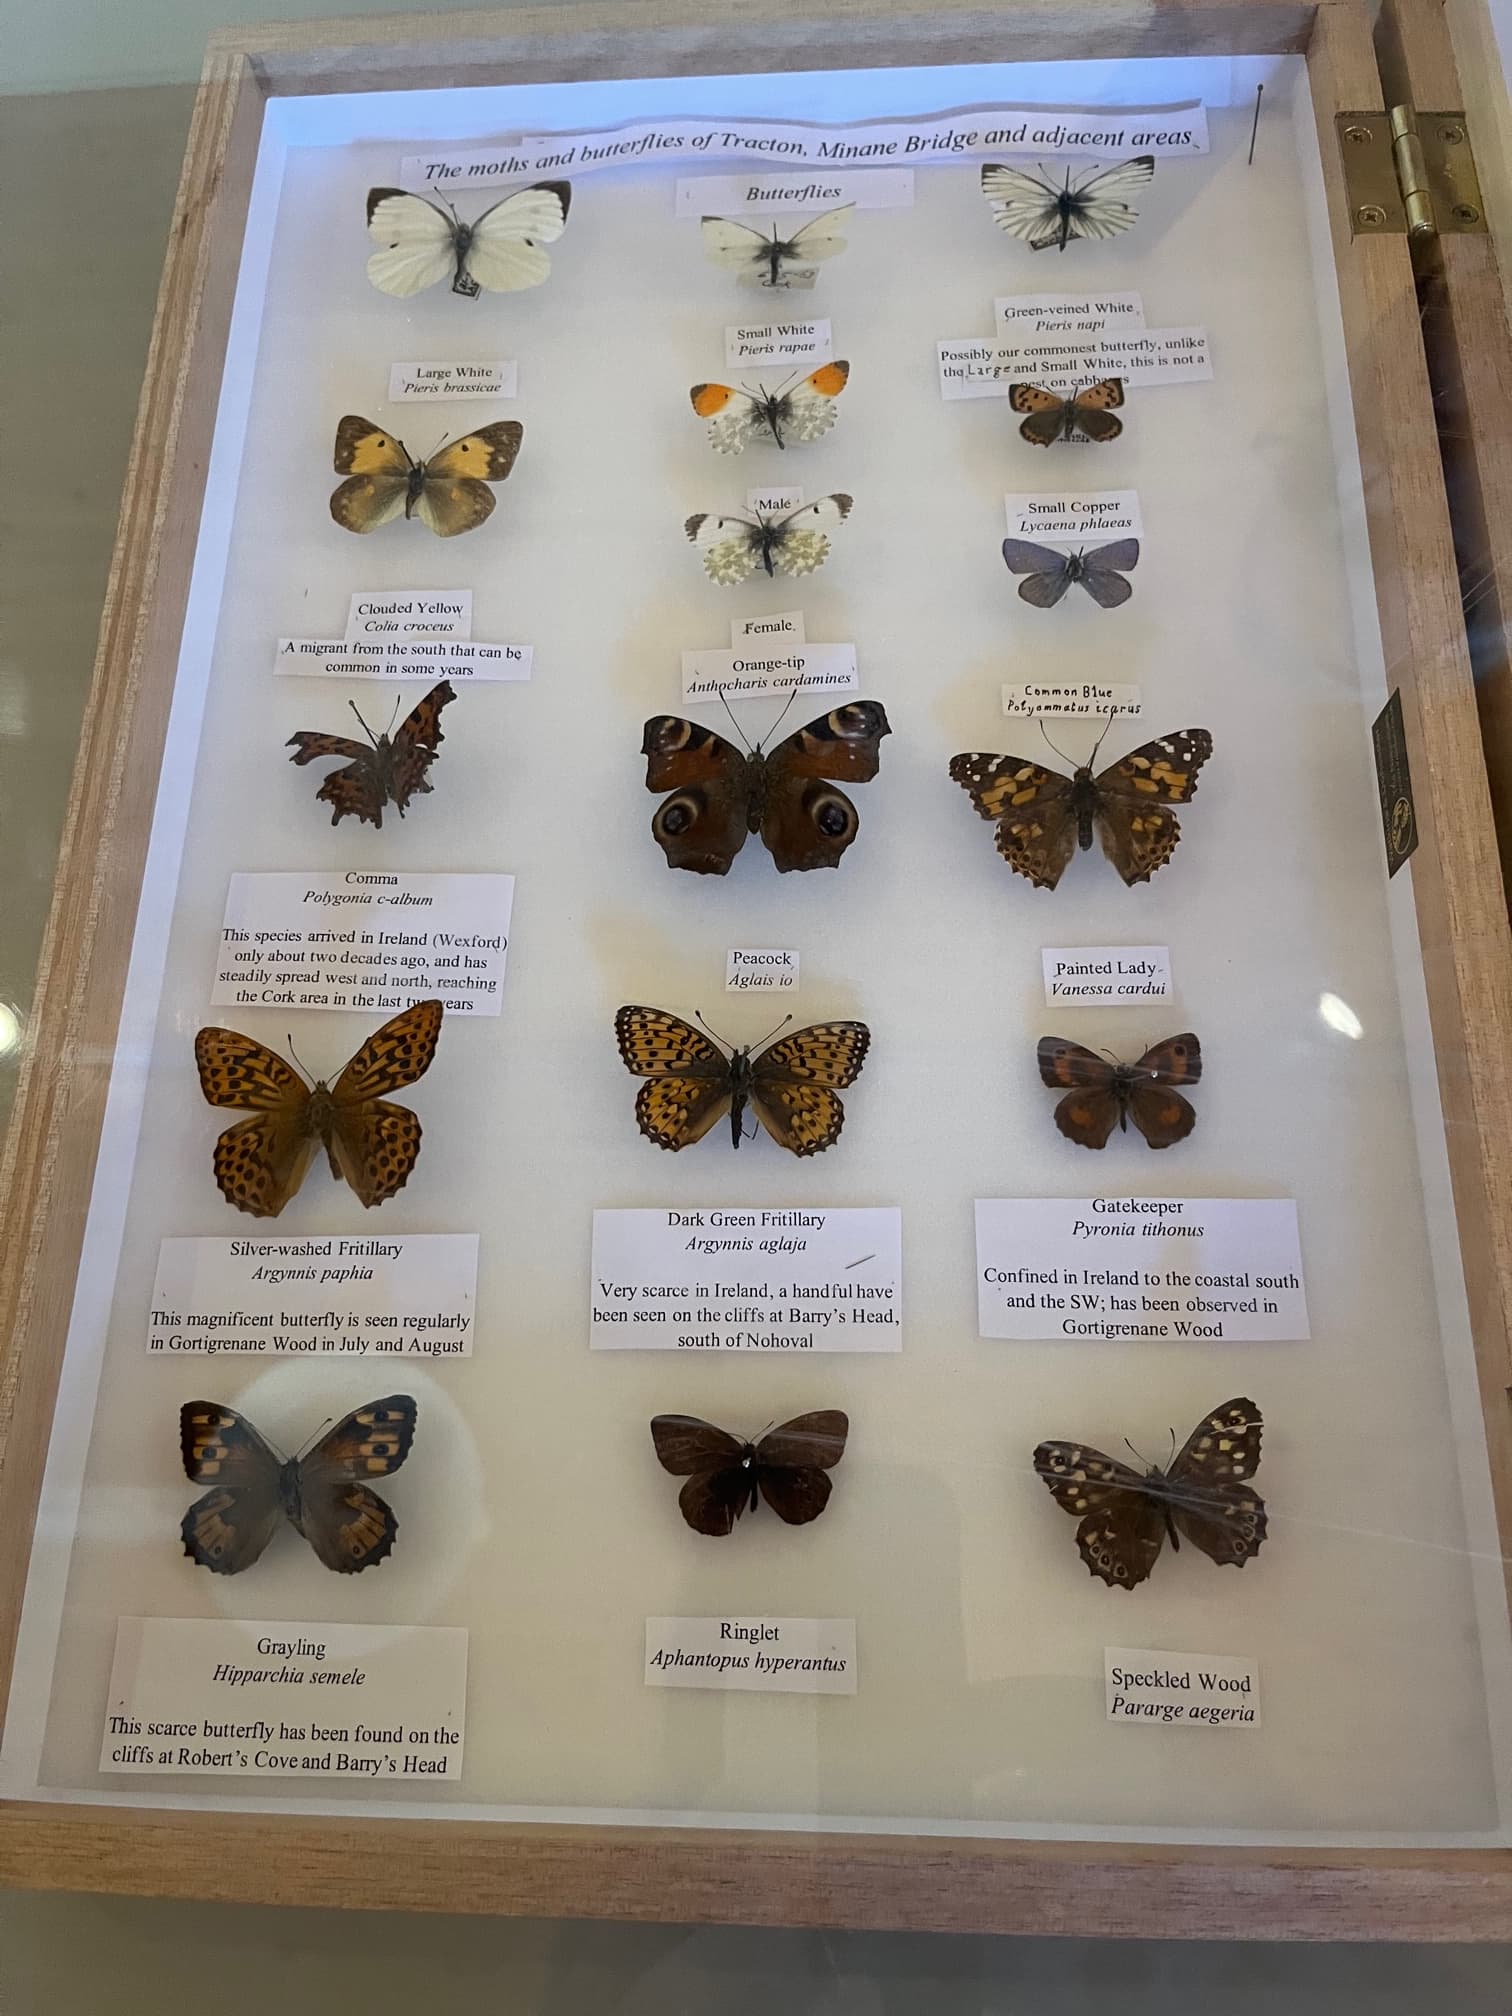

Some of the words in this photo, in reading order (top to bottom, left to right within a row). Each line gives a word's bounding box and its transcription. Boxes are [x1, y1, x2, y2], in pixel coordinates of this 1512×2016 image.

[425, 163, 462, 180] The
[468, 156, 529, 174] moths
[536, 147, 576, 169] and
[580, 133, 685, 162] butterflies
[691, 132, 719, 150] of
[721, 132, 808, 157] Tracton,
[817, 141, 898, 159] Minane
[904, 130, 978, 152] Bridge
[985, 124, 1027, 144] and
[1032, 125, 1124, 148] adjacent
[1131, 130, 1192, 146] areas
[746, 184, 842, 202] Butterflies
[1004, 303, 1089, 319] Green-veined
[1095, 302, 1134, 313] White
[737, 327, 772, 340] Small
[777, 324, 815, 336] White
[1035, 320, 1072, 332] Pieris
[1077, 319, 1105, 332] napi
[739, 344, 774, 356] Pieris
[779, 343, 816, 354] rapae
[941, 348, 992, 361] Possibly
[998, 349, 1020, 358] our
[1023, 344, 1096, 356] commonest
[1100, 340, 1161, 352] butterfly,
[1165, 338, 1205, 349] unlike
[417, 368, 452, 380] Large
[456, 367, 493, 377] White
[404, 383, 439, 393] Pieris
[444, 382, 502, 393] brassicae
[759, 498, 791, 510] Male
[1028, 502, 1065, 514] Small
[1070, 501, 1120, 514] Copper
[1020, 520, 1076, 534] Lycaena
[1080, 518, 1132, 532] phlaeas
[358, 603, 412, 615] Clouded
[417, 603, 464, 615] Yellow
[364, 621, 399, 632] Colia
[404, 622, 454, 632] croceus
[745, 620, 792, 634] Female
[285, 642, 295, 653] A
[300, 643, 348, 656] migrant
[353, 643, 384, 655] from
[387, 644, 408, 655] the
[411, 644, 446, 656] south
[450, 645, 475, 657] that
[479, 648, 502, 658] can
[506, 647, 522, 659] be
[325, 662, 380, 673] common
[385, 662, 397, 673] in
[401, 664, 435, 675] some
[439, 664, 474, 677] years
[732, 656, 805, 672] Orange-tip
[686, 678, 768, 693] Anthocharis
[773, 672, 852, 688] cardamines
[1025, 685, 1078, 696] Common
[1083, 685, 1112, 697] Blue
[1007, 699, 1089, 717] Polyommatus
[1096, 700, 1142, 714] icarus
[345, 872, 398, 885] Comma
[303, 891, 372, 906] Polygonia
[377, 893, 433, 906] c-album
[222, 928, 250, 941] This
[254, 929, 302, 944] species
[307, 929, 356, 943] arrived
[361, 931, 373, 943] in
[378, 932, 428, 946] Ireland
[432, 934, 508, 951] (Wexford)
[234, 949, 264, 964] only
[267, 949, 305, 962] about
[310, 952, 337, 963] two
[340, 951, 397, 965] decades
[400, 957, 430, 969] ago,
[434, 955, 460, 968] and
[464, 955, 488, 969] has
[733, 951, 791, 965] Peacock
[1056, 961, 1112, 975] Painted
[1117, 961, 1156, 977] Lady
[219, 969, 272, 984] steadily
[275, 970, 320, 985] spread
[326, 974, 357, 985] west
[361, 973, 387, 986] and
[391, 974, 432, 989] north,
[437, 976, 497, 993] reaching
[728, 972, 774, 989] Aglais
[779, 974, 793, 986] io
[1052, 983, 1112, 995] Vanessa
[1117, 982, 1166, 995] cardui
[1092, 1198, 1184, 1217] Gatekeeper
[668, 1212, 705, 1226] Dark
[710, 1212, 756, 1226] Green
[761, 1212, 826, 1230] Fritillary
[1072, 1221, 1135, 1239] Pyronia
[1142, 1222, 1205, 1237] tithonus
[230, 1241, 331, 1256] Silver-washed
[338, 1241, 403, 1259] Fritillary
[685, 1236, 754, 1254] Argynnis
[759, 1236, 807, 1254] aglaja
[252, 1265, 317, 1283] Argynnis
[320, 1265, 374, 1283] paphia
[984, 1267, 1058, 1284] Confined
[1064, 1269, 1078, 1284] in
[1083, 1270, 1139, 1285] Ireland
[1144, 1274, 1161, 1286] to
[1166, 1271, 1191, 1286] the
[1194, 1273, 1249, 1288] coastal
[1255, 1273, 1299, 1289] south
[600, 1283, 637, 1301] Very
[642, 1286, 689, 1297] scarce
[695, 1282, 709, 1297] in
[715, 1283, 774, 1300] Ireland,
[779, 1287, 787, 1298] a
[793, 1283, 852, 1299] handful
[856, 1283, 894, 1299] have
[151, 1311, 181, 1326] This
[186, 1311, 273, 1329] magnificent
[280, 1312, 344, 1330] butterfly
[348, 1312, 359, 1327] is
[365, 1316, 398, 1327] seen
[403, 1313, 471, 1331] regularly
[1063, 1319, 1168, 1339] Gortigrenane
[1173, 1321, 1223, 1337] Wood
[678, 1332, 720, 1348] south
[725, 1332, 744, 1347] of
[747, 1333, 813, 1348] Nohoval
[720, 1622, 780, 1645] Ringlet
[257, 1638, 326, 1660] Grayling
[650, 1648, 750, 1672] Aphantopus
[755, 1651, 847, 1674] hyperantus
[212, 1664, 304, 1686] Hipparchia
[309, 1668, 366, 1685] semele
[1112, 1668, 1191, 1691] Speckled
[1198, 1673, 1252, 1692] Wood
[1111, 1696, 1184, 1722] Pararge
[1189, 1705, 1255, 1725] aegeria
[109, 1716, 142, 1735] This
[147, 1723, 197, 1736] scarce
[203, 1720, 274, 1743] butterfly
[279, 1722, 306, 1740] has
[311, 1723, 349, 1742] been
[354, 1724, 403, 1743] found
[409, 1731, 429, 1745] on
[434, 1727, 460, 1745] the
[112, 1745, 154, 1764] cliffs
[158, 1749, 173, 1764] at
[254, 1750, 298, 1768] Cove
[302, 1753, 331, 1770] and
[402, 1755, 448, 1774] Head
